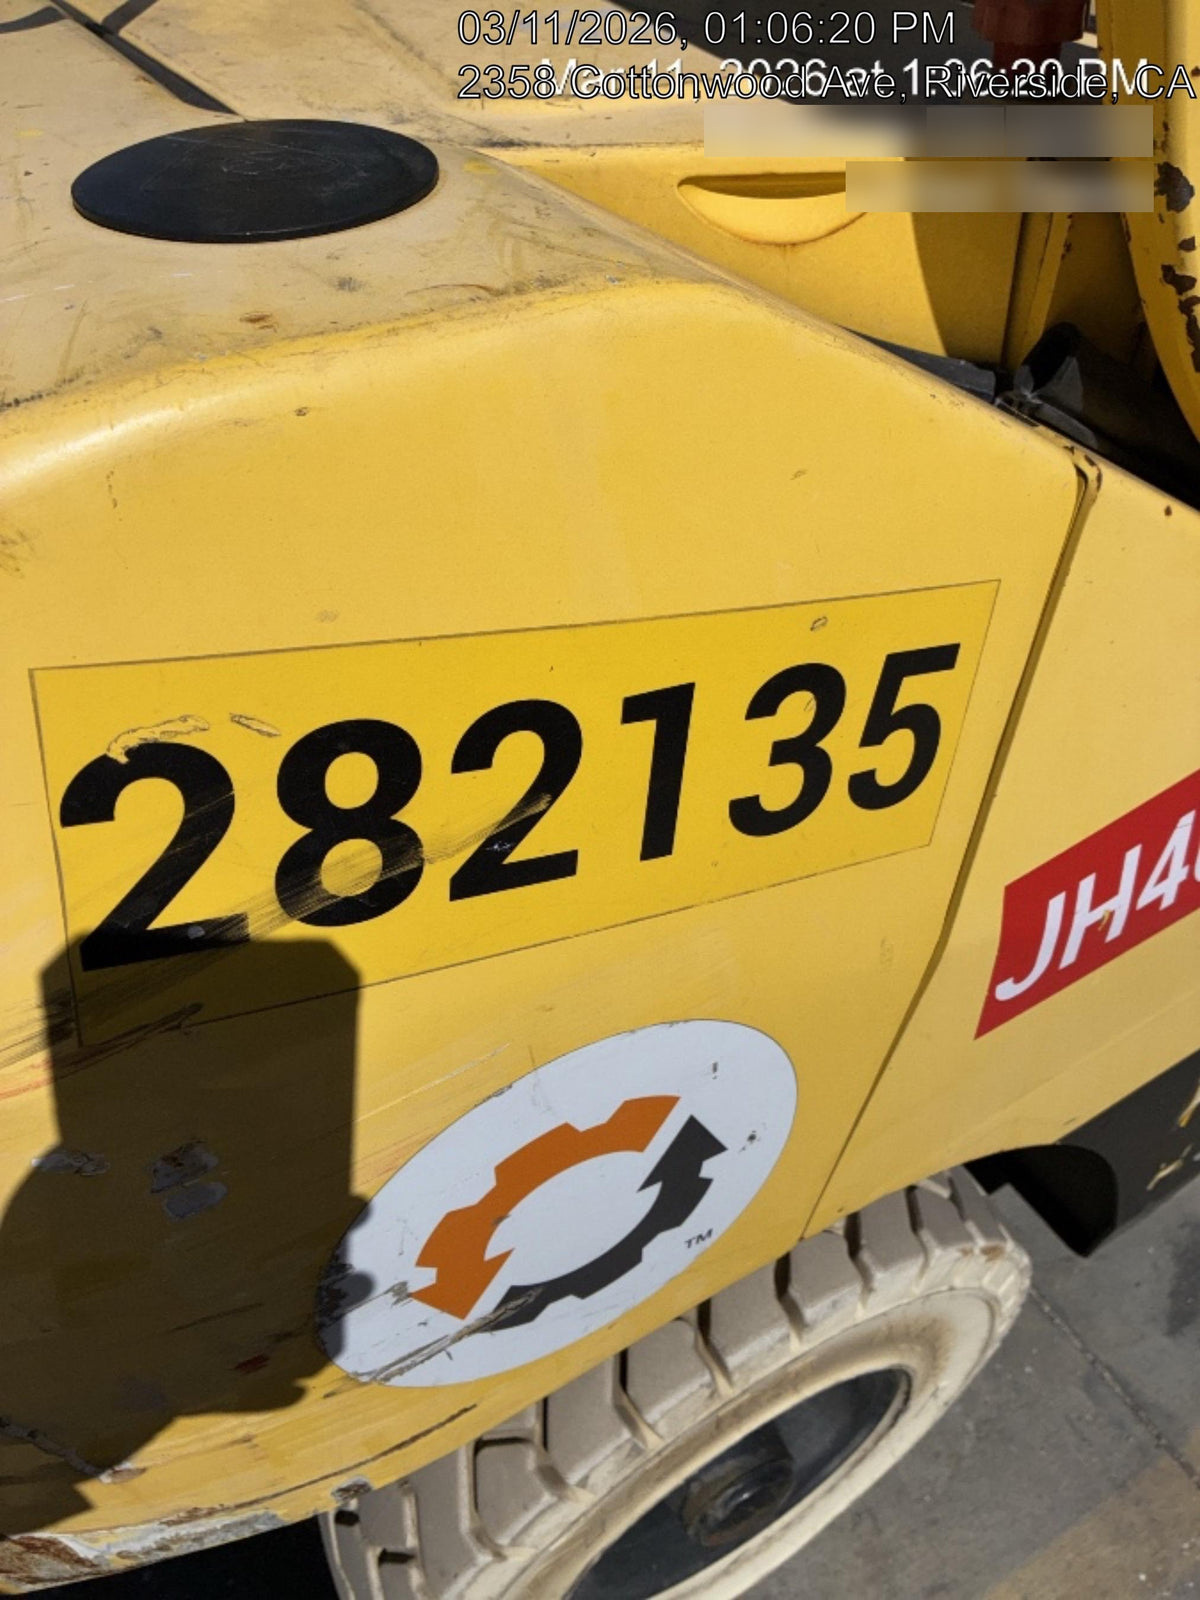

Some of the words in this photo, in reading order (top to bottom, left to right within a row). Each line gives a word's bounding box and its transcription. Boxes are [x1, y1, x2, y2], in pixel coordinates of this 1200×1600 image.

[59, 642, 961, 971] 282135
[995, 809, 1200, 1001] JH4
[684, 1227, 713, 1249] TM
